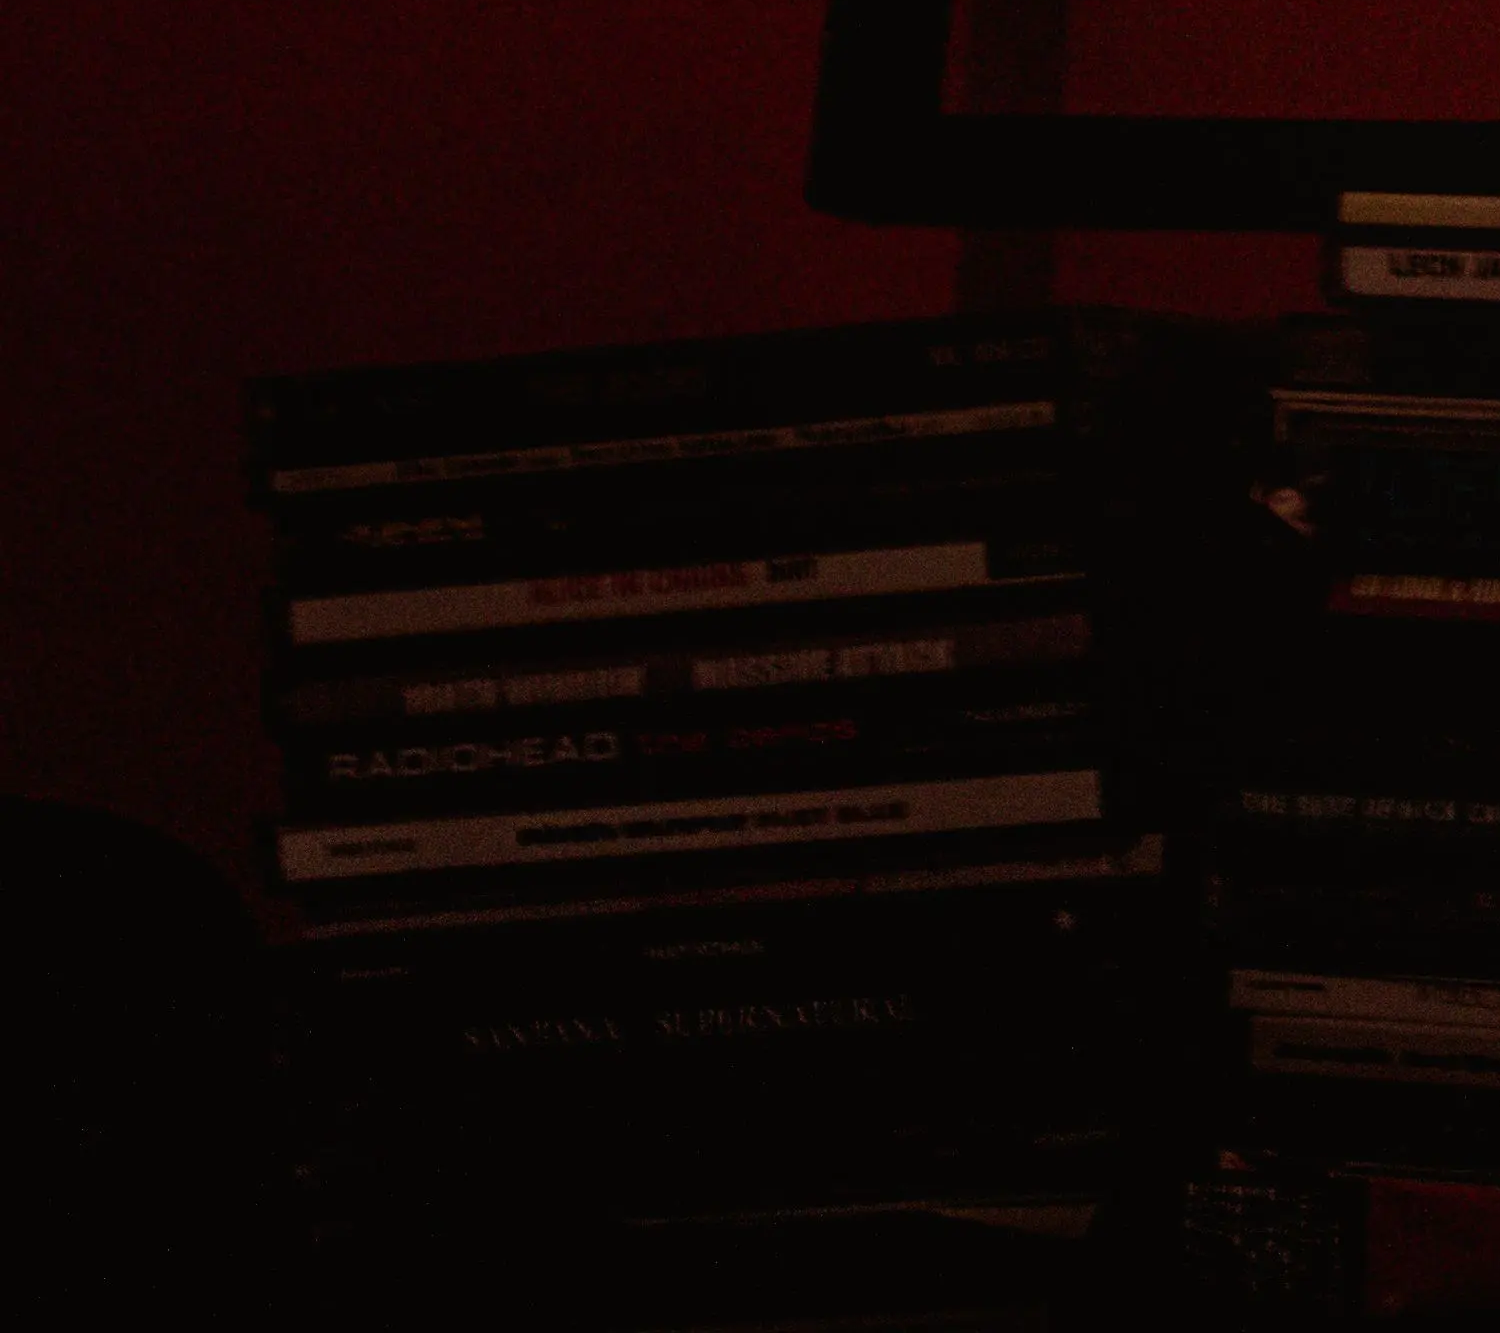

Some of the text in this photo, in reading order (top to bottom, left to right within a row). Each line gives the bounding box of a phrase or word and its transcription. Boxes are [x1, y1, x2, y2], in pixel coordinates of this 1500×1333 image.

[328, 731, 625, 783] RADIOHEAD
[460, 993, 918, 1055] SANTANA SUPERNATURAL
